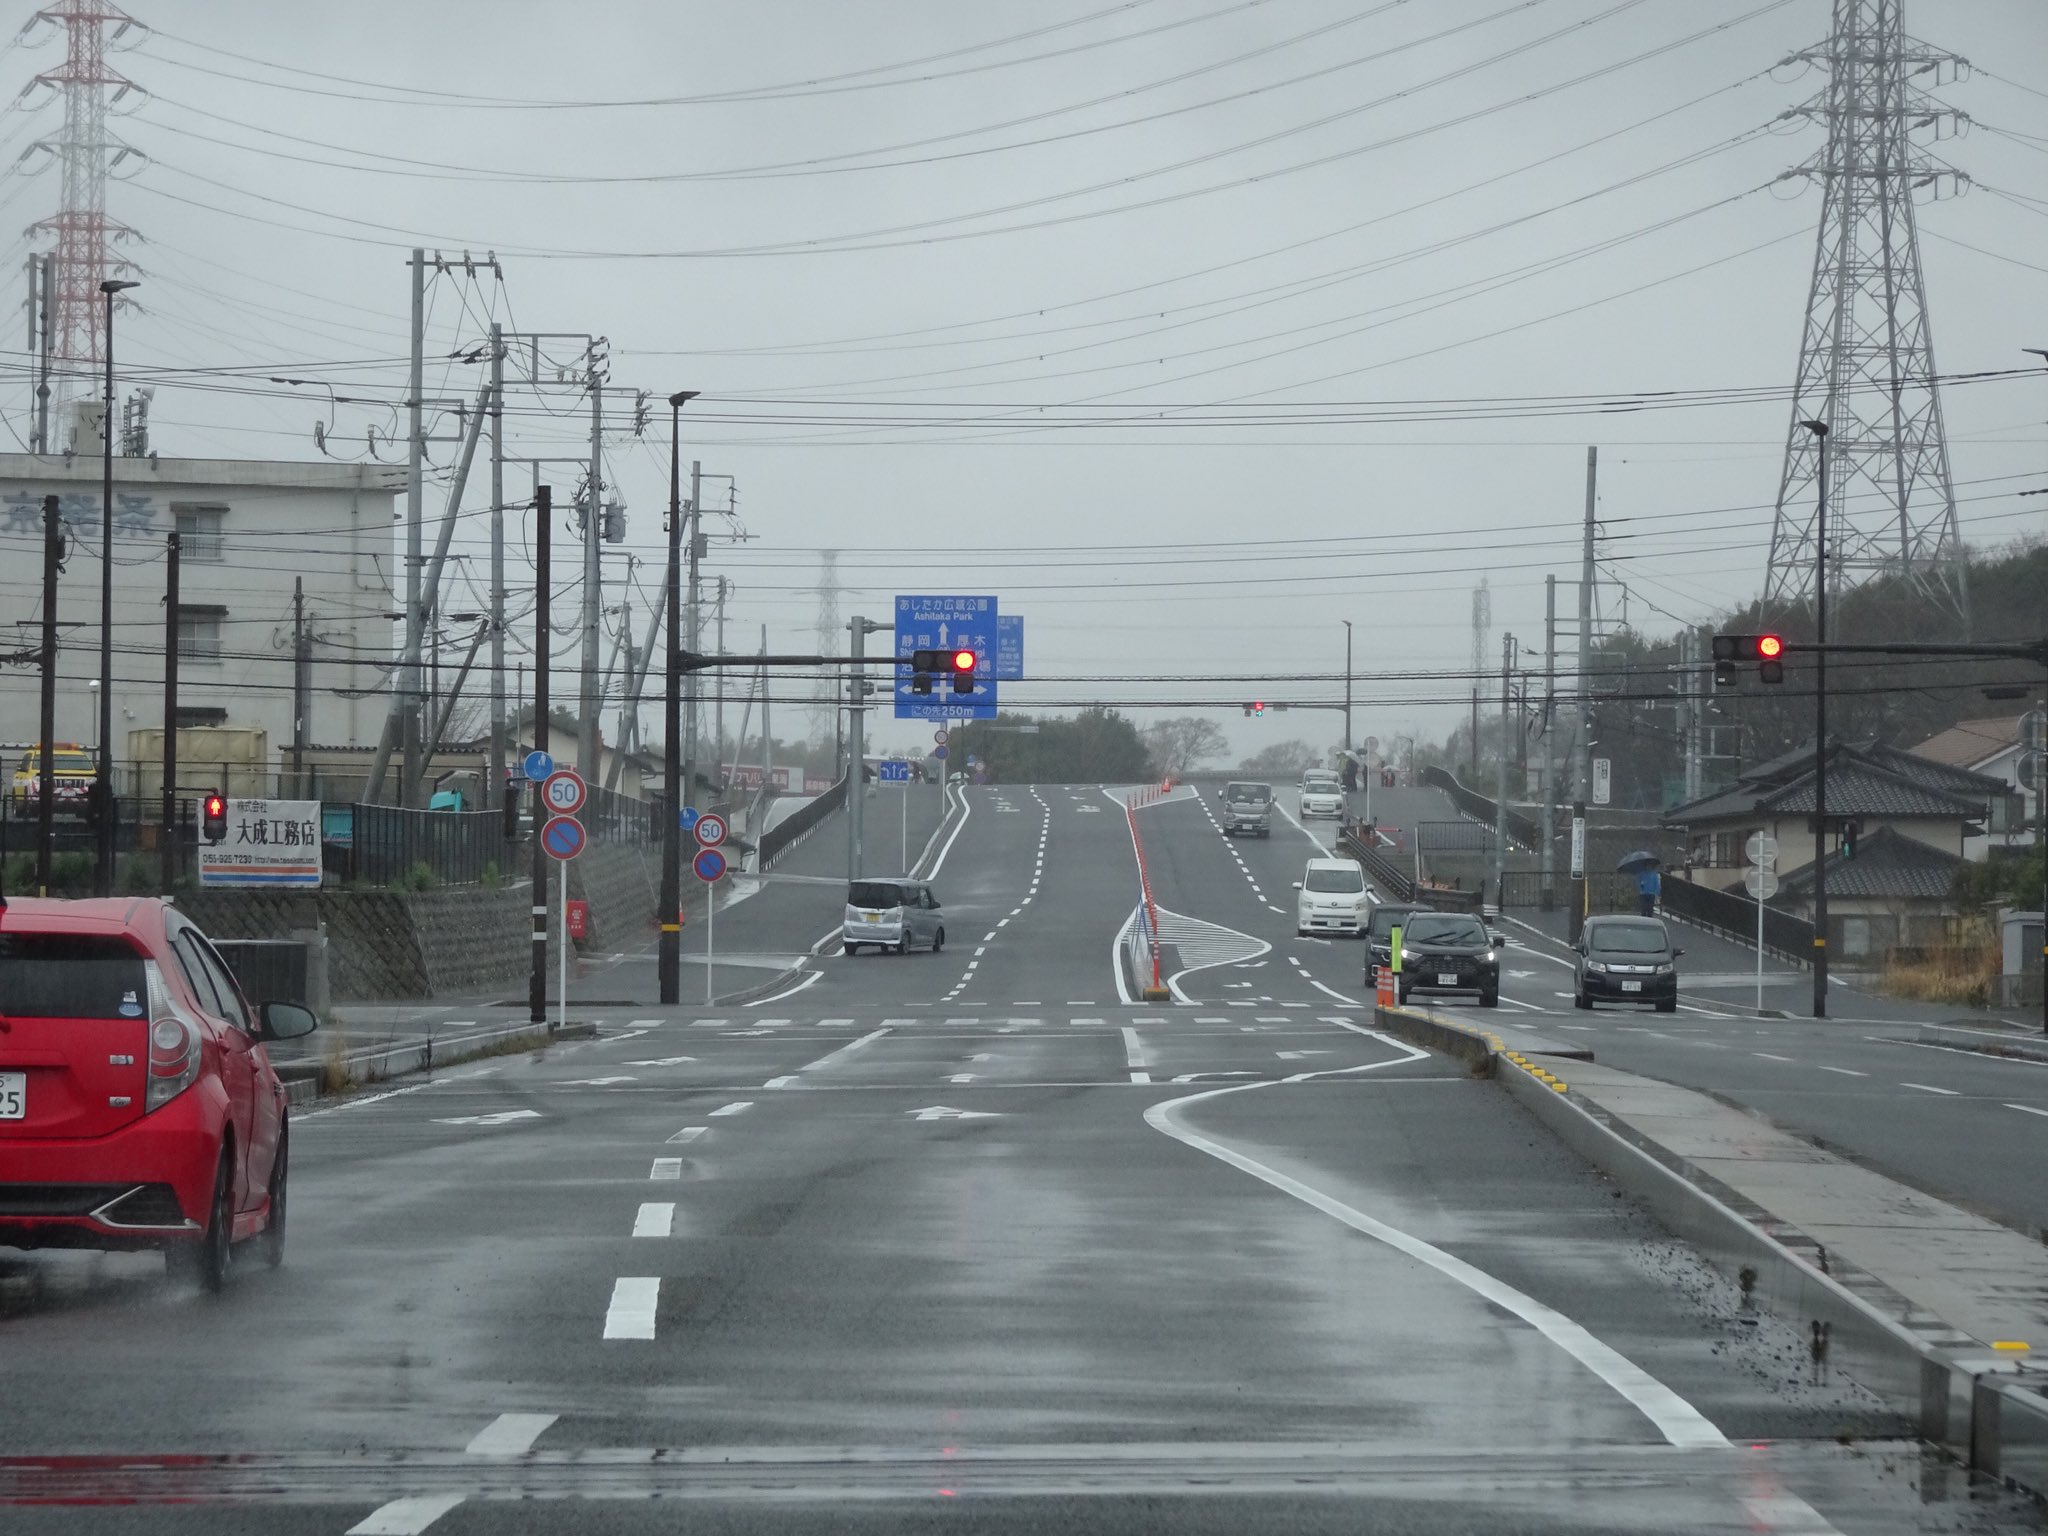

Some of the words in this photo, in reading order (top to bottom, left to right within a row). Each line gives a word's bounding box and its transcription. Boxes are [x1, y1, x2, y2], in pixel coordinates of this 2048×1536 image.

[914, 612, 951, 621] Ashitaka
[953, 613, 974, 621] Park
[901, 634, 931, 647] 静岡
[957, 634, 986, 647] 厚木
[912, 706, 974, 717] この先250m
[552, 783, 576, 802] 50
[237, 801, 268, 813] 株式会社
[236, 818, 316, 846] 大成工務店
[700, 824, 720, 838] 50
